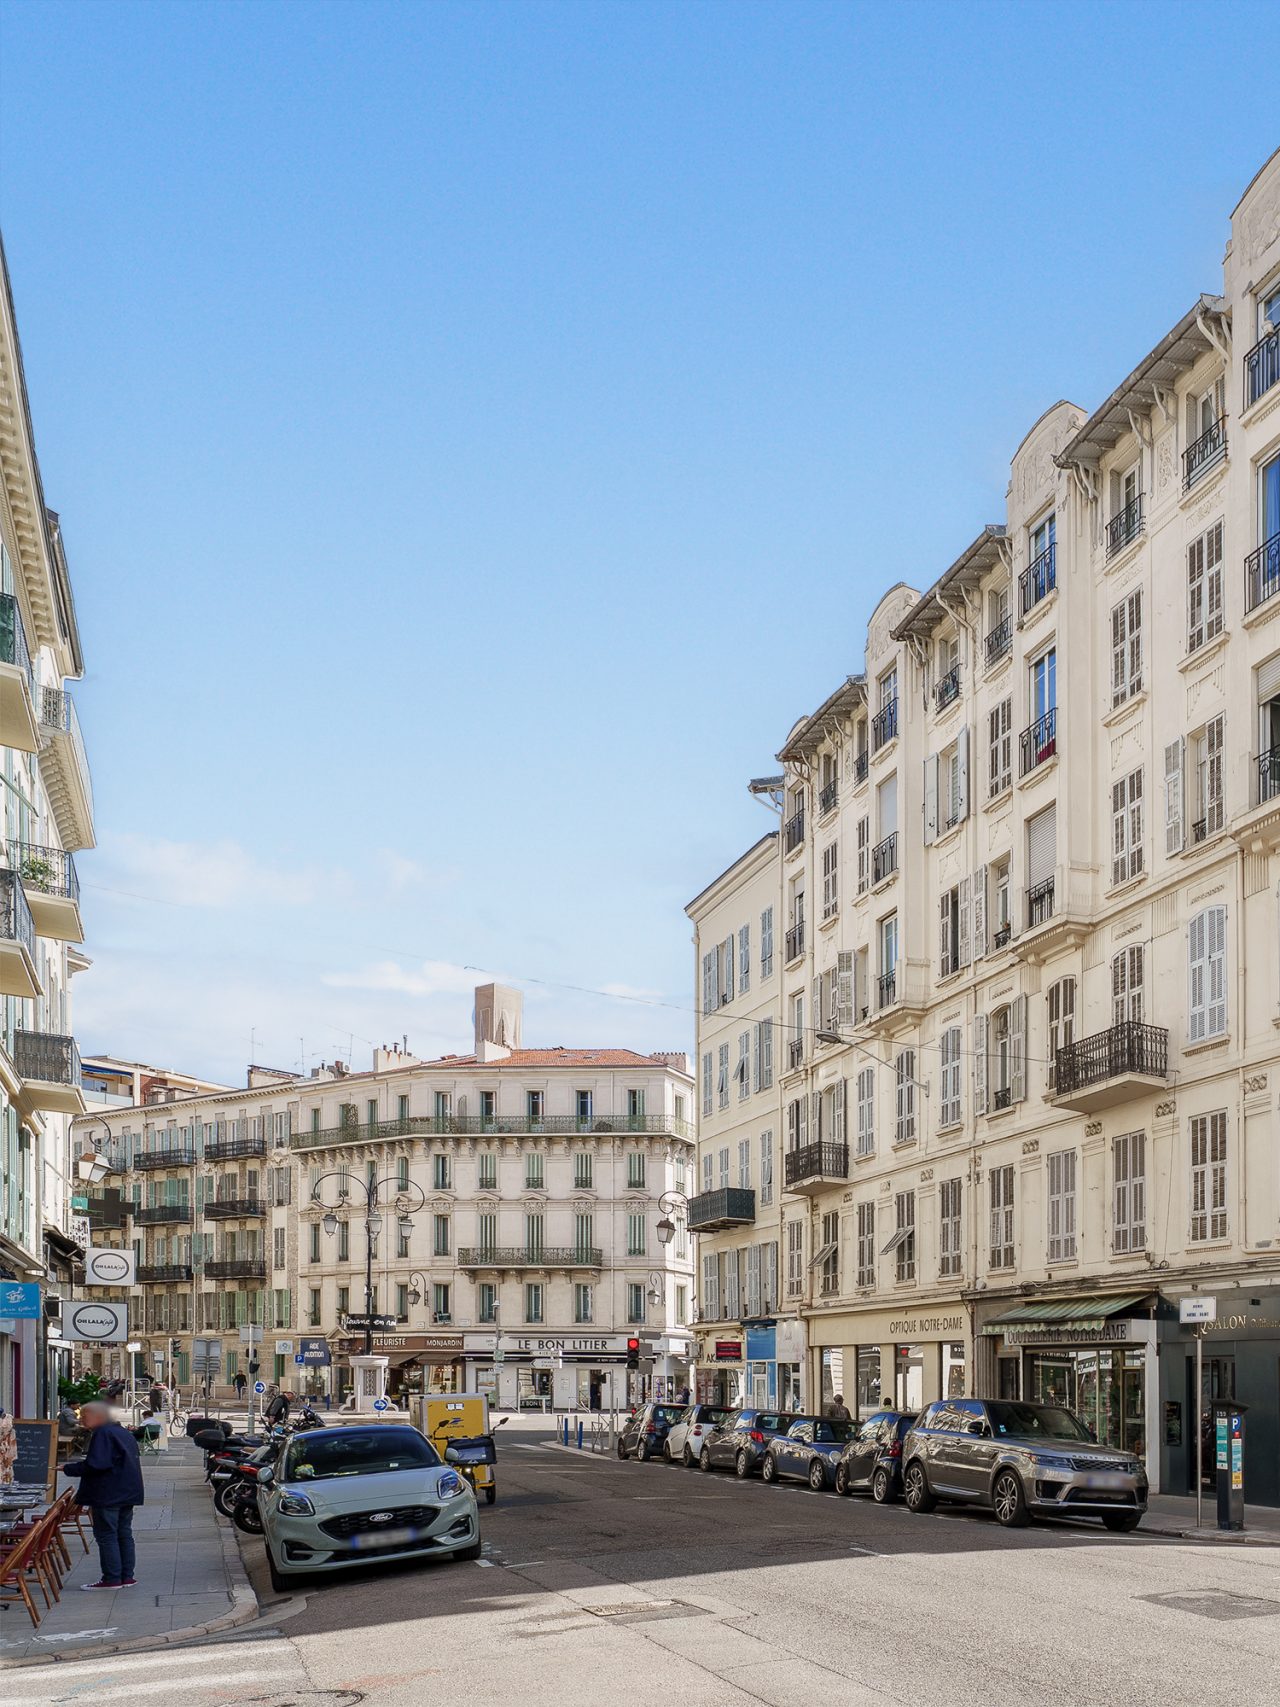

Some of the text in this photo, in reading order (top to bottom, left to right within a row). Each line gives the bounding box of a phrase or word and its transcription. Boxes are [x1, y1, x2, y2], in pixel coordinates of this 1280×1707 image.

[889, 1316, 963, 1334] OPTIQUE NOTRE-DAME
[1208, 1314, 1247, 1330] SALON
[373, 1337, 406, 1347] FLEURISTE
[518, 1339, 608, 1350] LE BON LITIER
